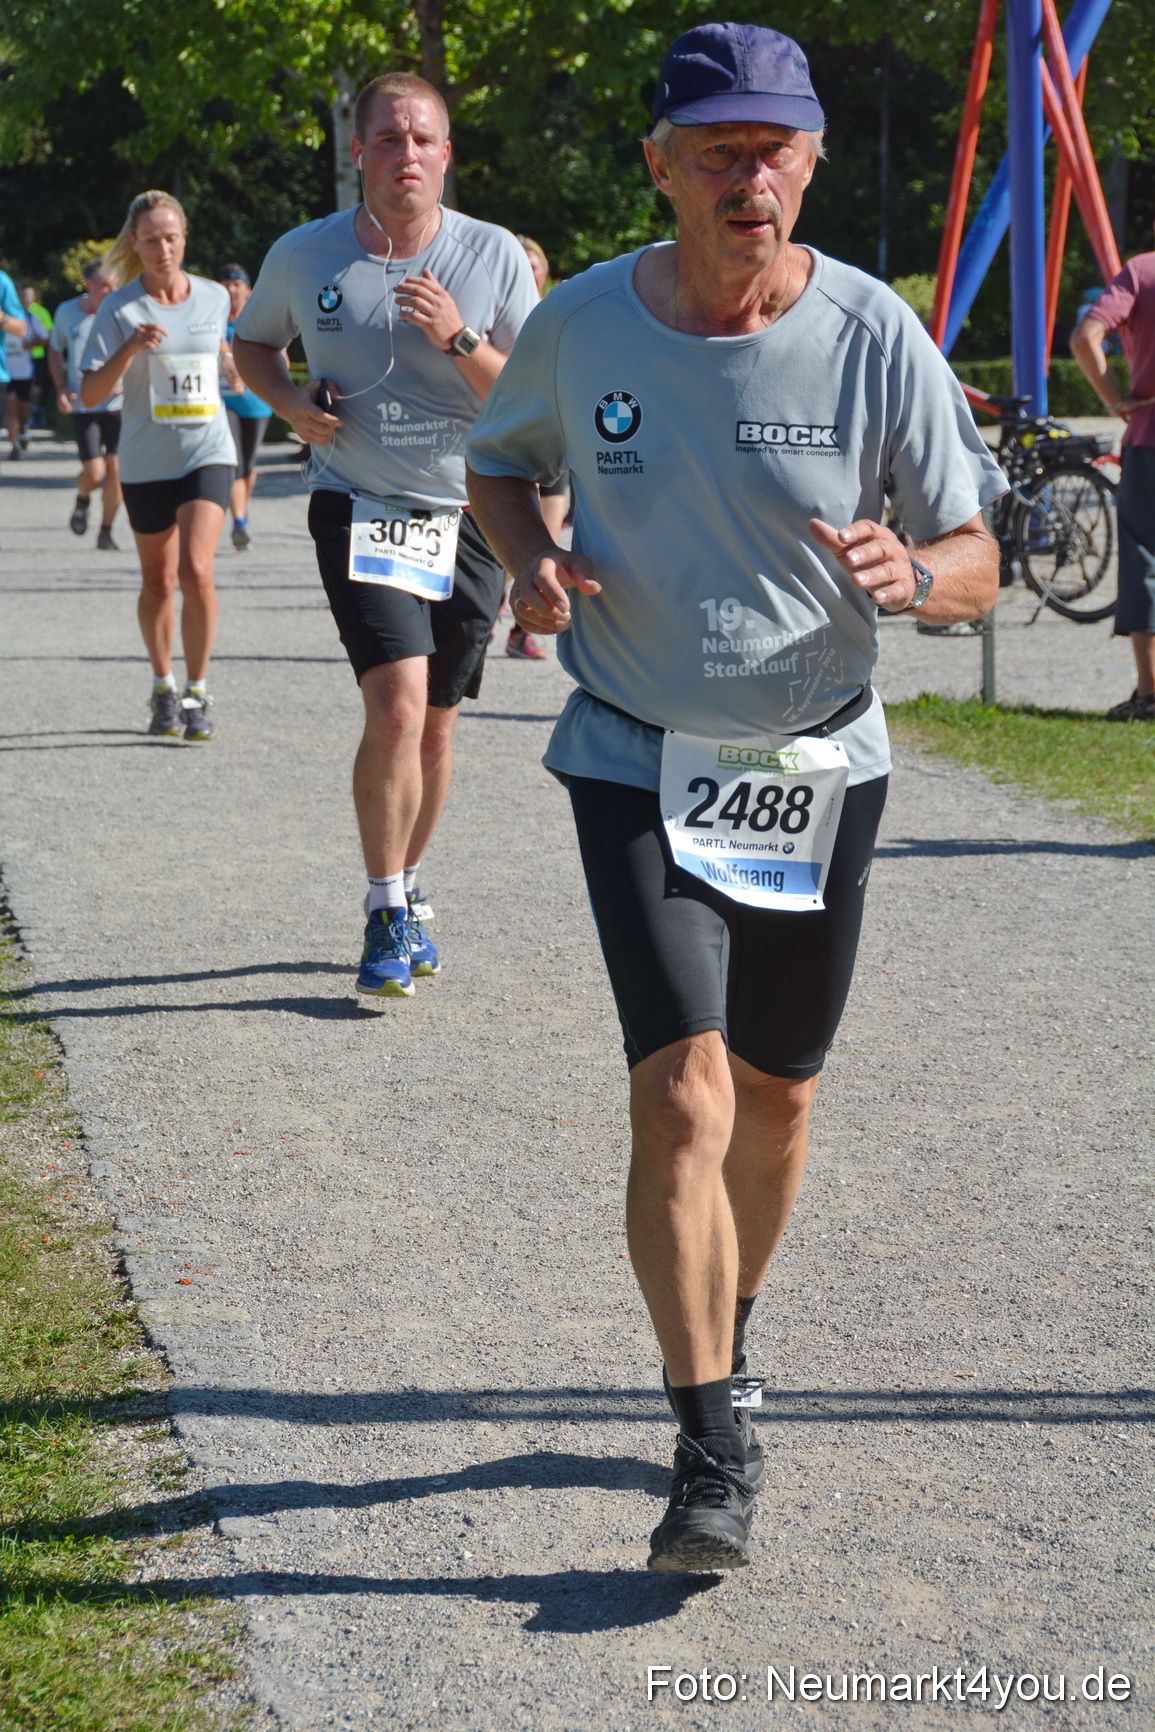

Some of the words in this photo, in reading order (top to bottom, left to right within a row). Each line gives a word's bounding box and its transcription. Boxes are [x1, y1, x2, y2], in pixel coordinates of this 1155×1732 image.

[317, 318, 342, 326] PARTL
[168, 374, 201, 394] 141
[377, 401, 410, 421] 19.
[380, 420, 449, 433] Neumarkter
[736, 421, 840, 448] BOCK
[381, 433, 438, 446] Stadtlauf
[596, 451, 643, 464] PARTL
[735, 444, 767, 454] inspired
[769, 447, 779, 456] by
[781, 448, 804, 456] smart
[806, 449, 841, 458] concepts
[598, 465, 644, 475] Neumarkt
[374, 547, 396, 555] PARTL
[398, 552, 426, 564] Neumarkt
[699, 597, 756, 632] 19.
[702, 629, 815, 654] Neumarkter
[703, 651, 799, 678] Stadtlauf
[798, 668, 824, 713] September
[822, 647, 837, 669] 2018
[718, 745, 799, 770] BOCK
[684, 777, 814, 834] 2488
[693, 838, 726, 849] PARTL
[729, 840, 778, 852] Neumarkt
[701, 860, 785, 893] Wolfgang
